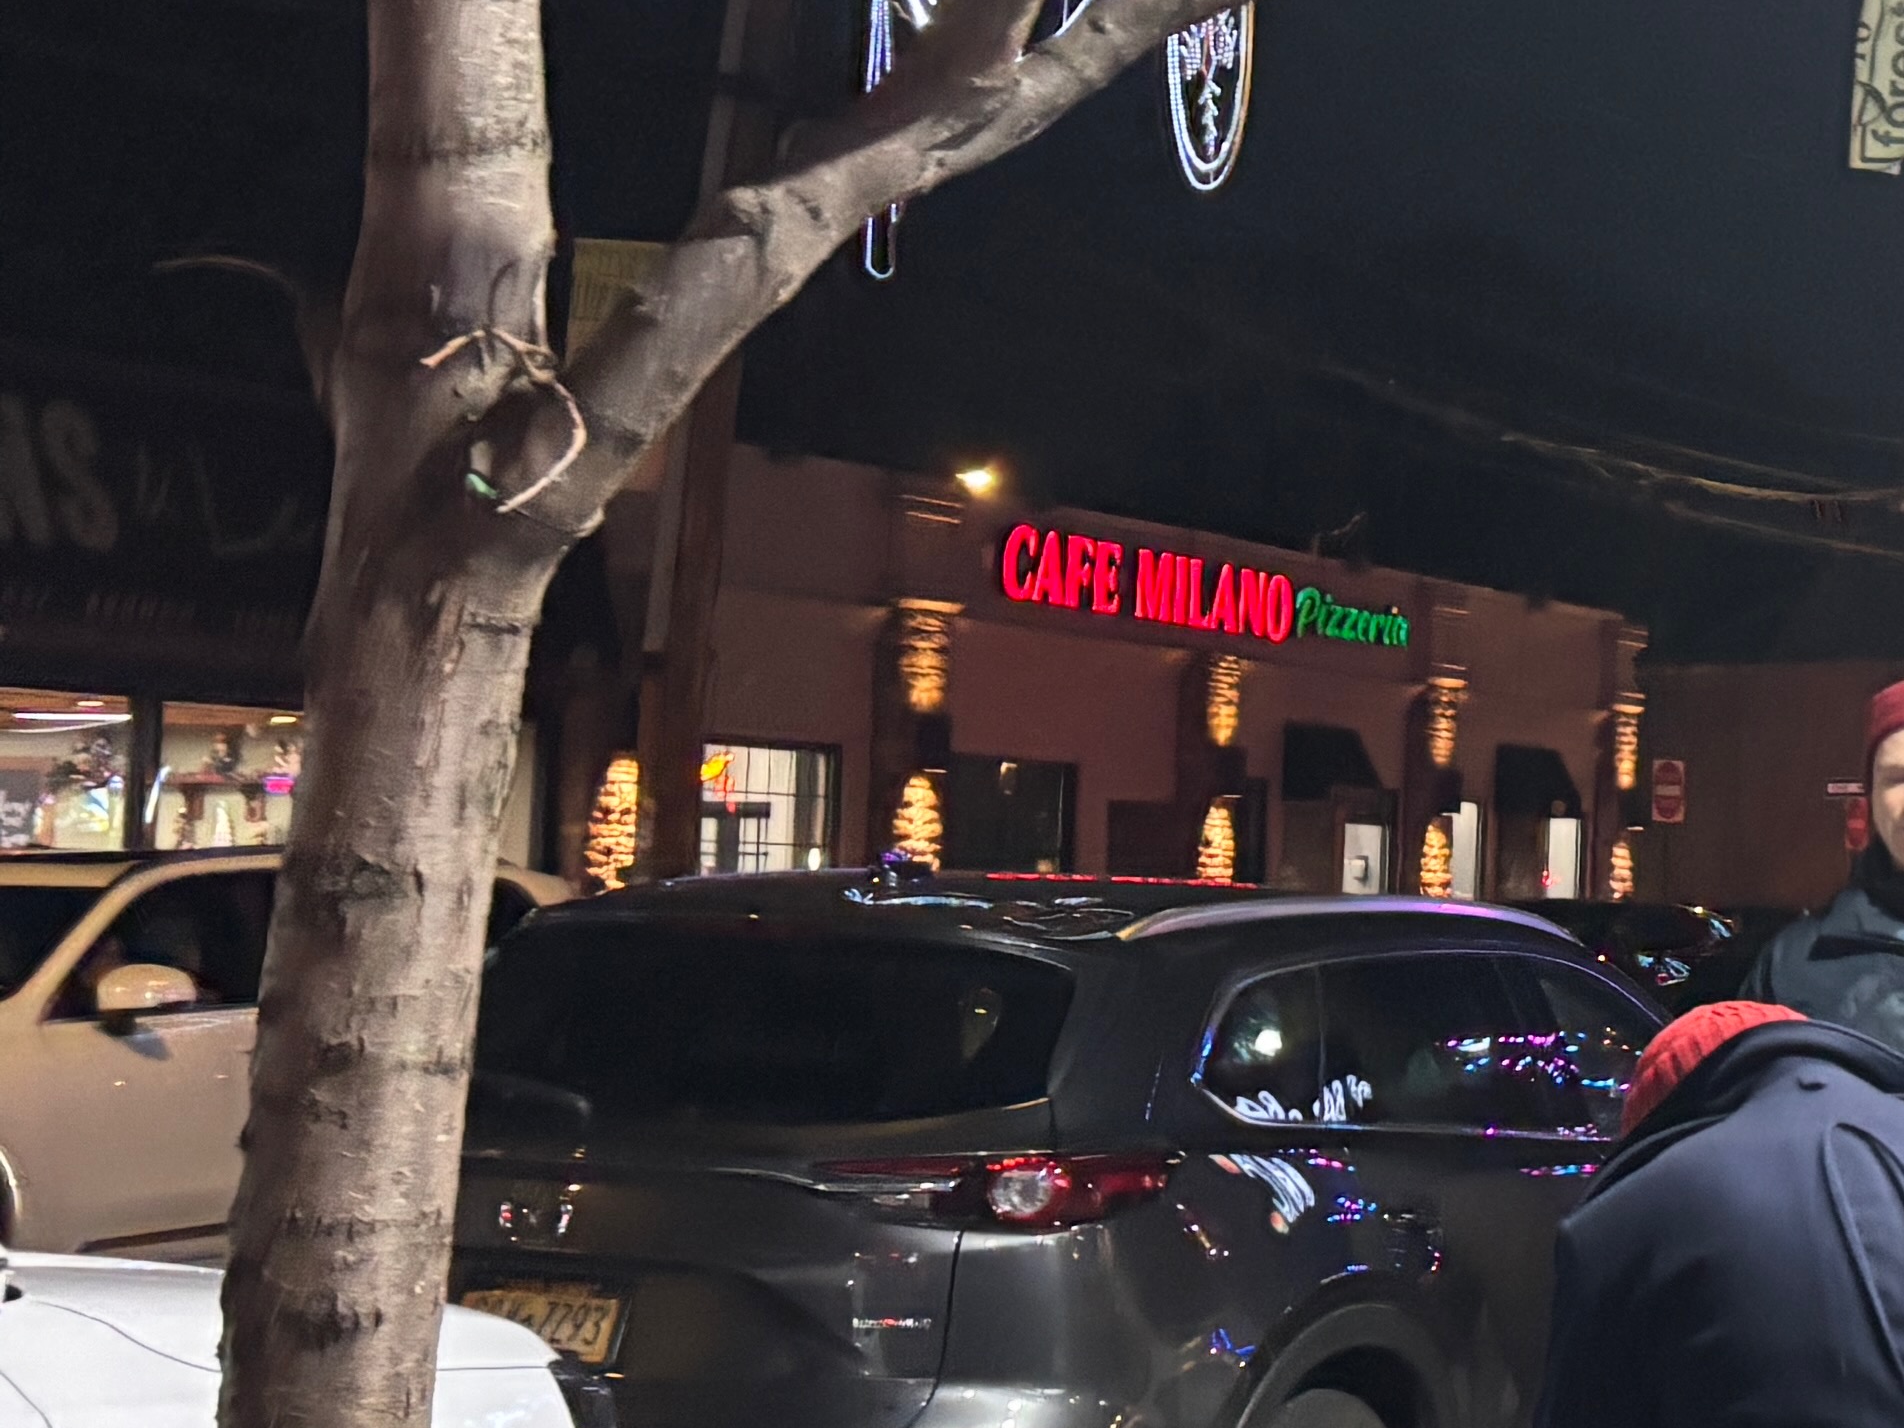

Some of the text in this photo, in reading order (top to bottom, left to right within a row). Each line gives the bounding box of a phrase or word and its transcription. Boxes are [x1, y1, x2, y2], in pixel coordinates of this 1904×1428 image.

[1003, 523, 1410, 648] CAFE MILANO Pizzeria
